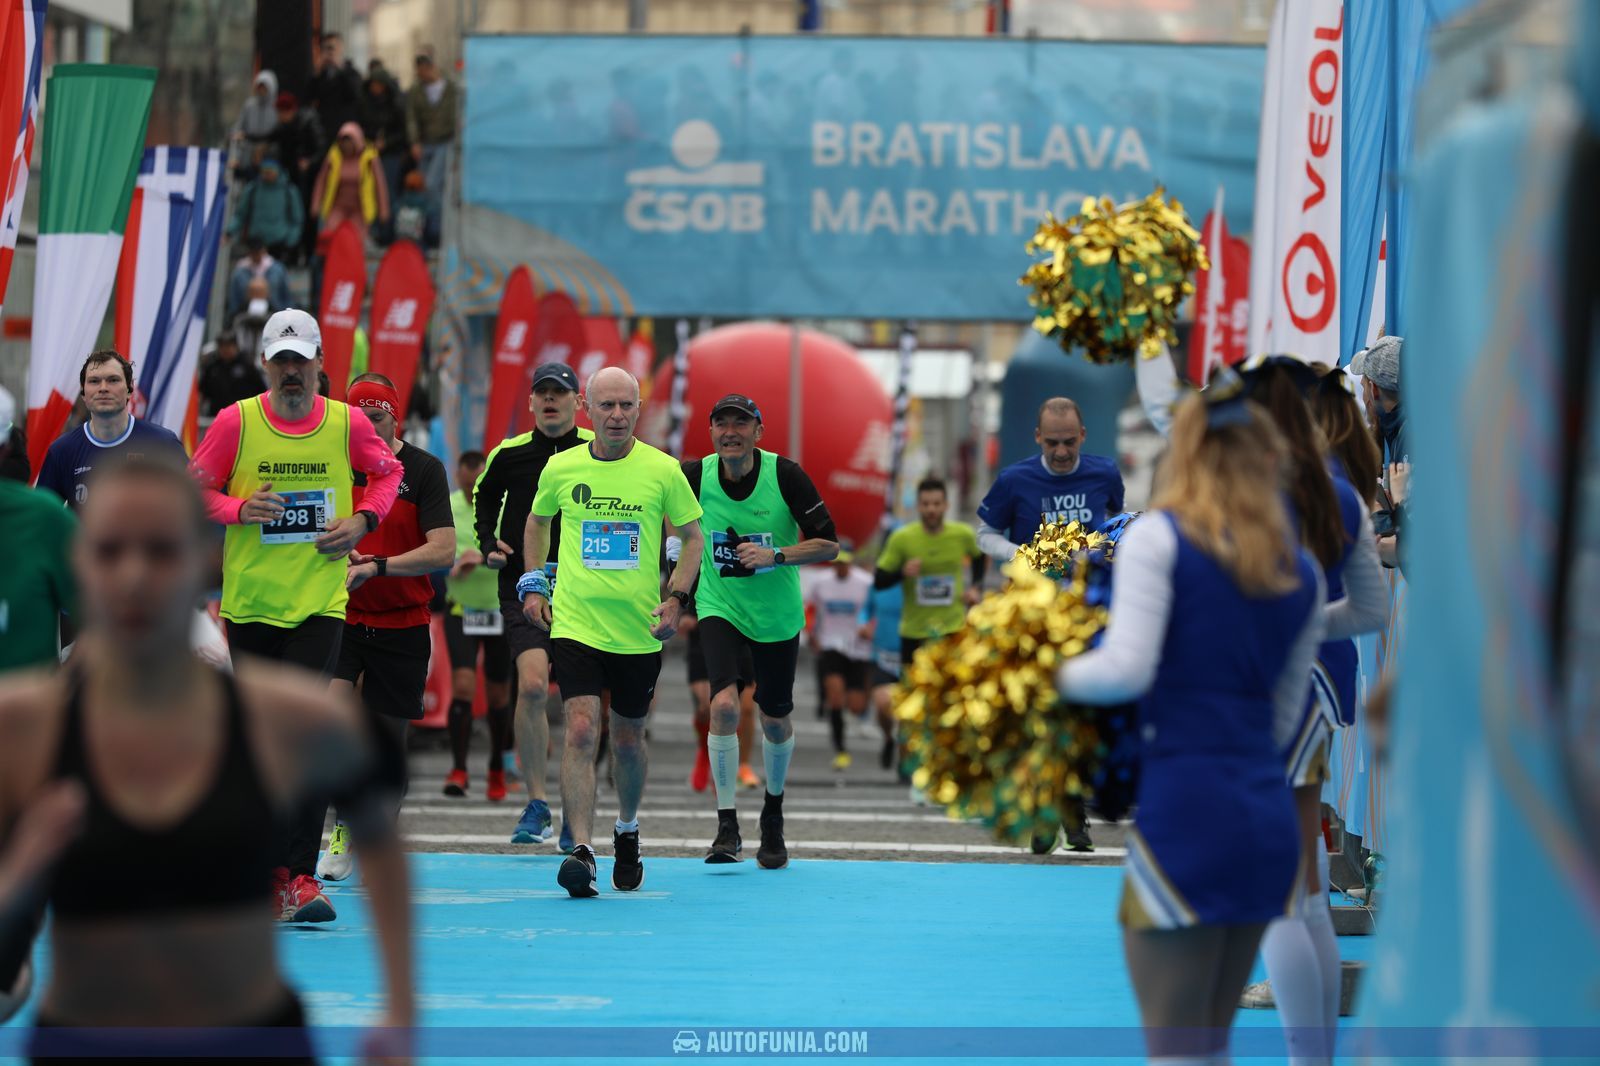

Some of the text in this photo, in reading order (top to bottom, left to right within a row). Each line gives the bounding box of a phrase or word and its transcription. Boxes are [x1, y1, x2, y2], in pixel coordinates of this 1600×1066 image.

[811, 121, 1152, 170] BRATISLAVA
[811, 188, 1137, 236] MARATHO
[272, 463, 327, 475] AUTOFUNIA
[258, 475, 331, 483] www.autofunia.com
[1053, 493, 1086, 510] YOU
[263, 508, 310, 527] 798
[583, 537, 610, 553] 215
